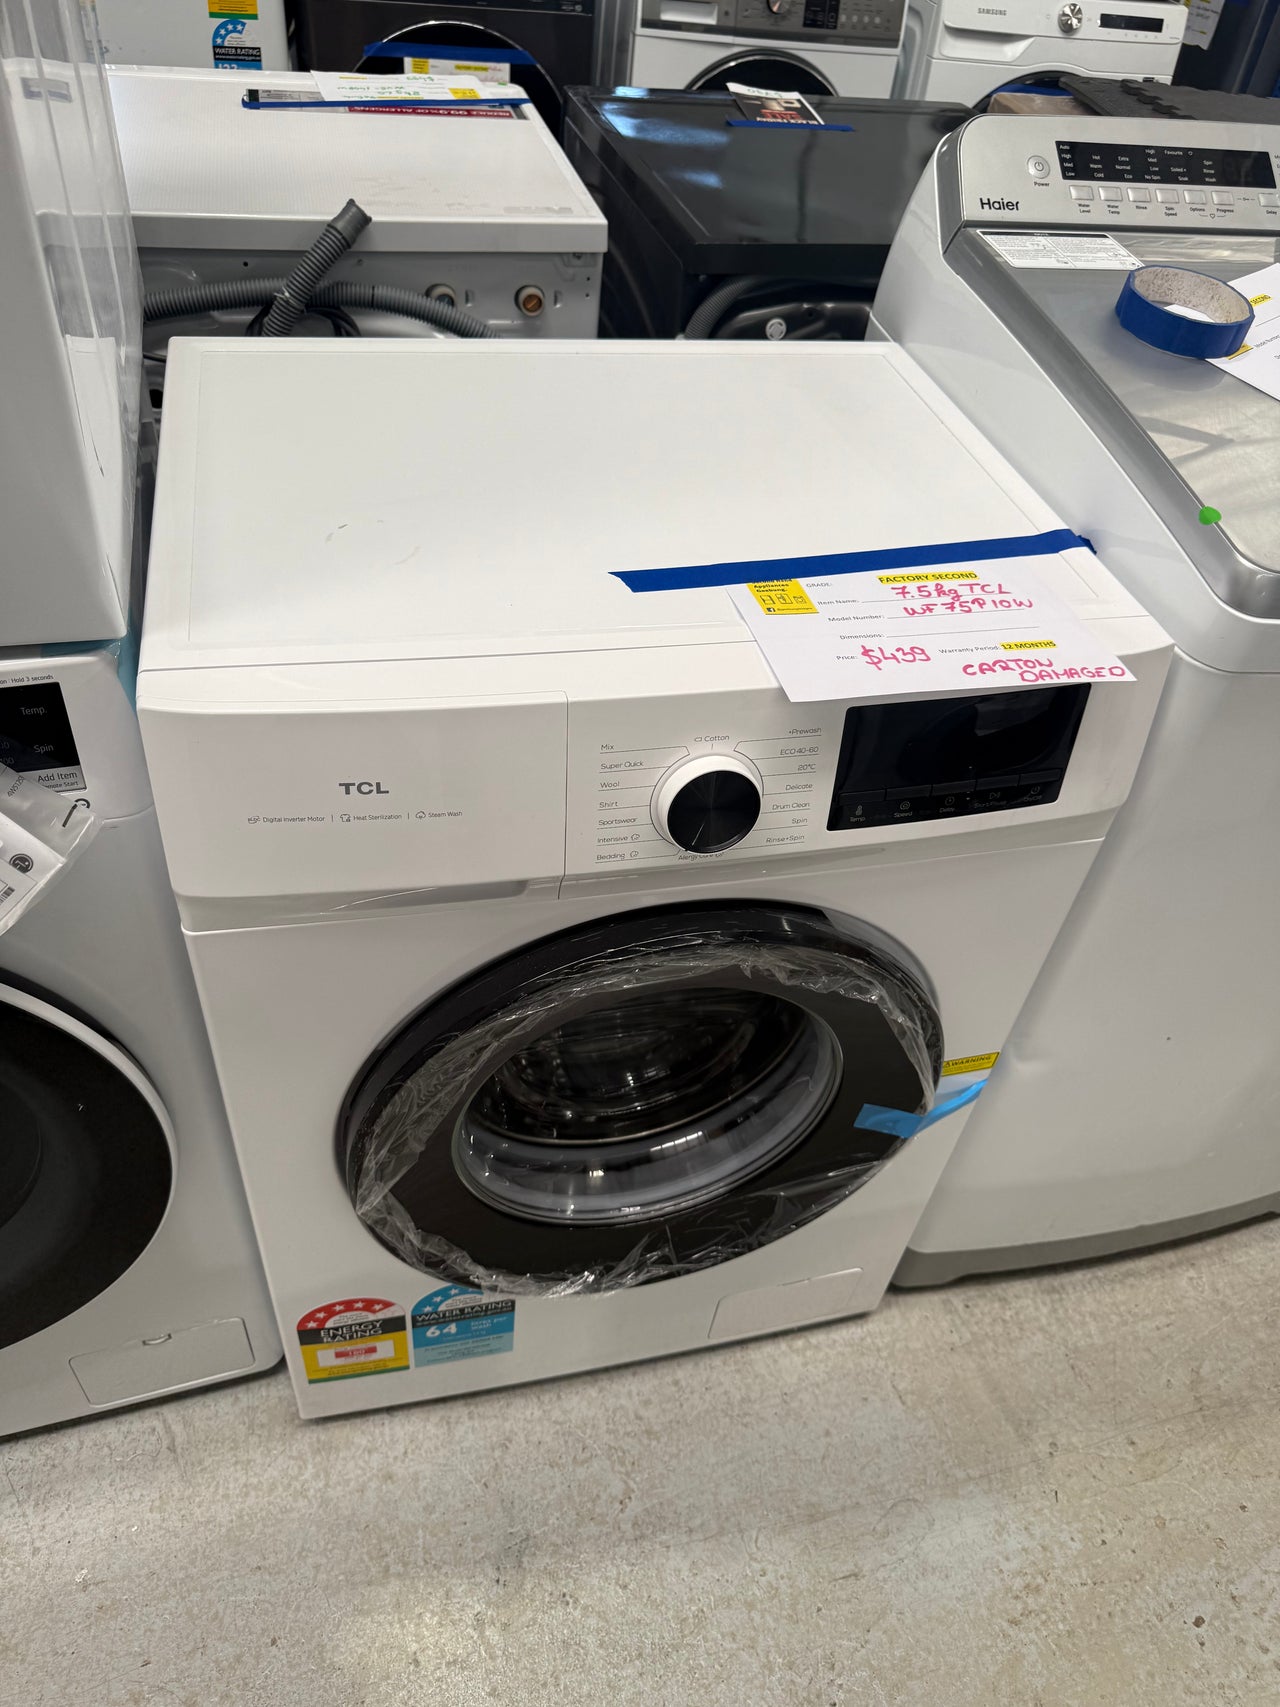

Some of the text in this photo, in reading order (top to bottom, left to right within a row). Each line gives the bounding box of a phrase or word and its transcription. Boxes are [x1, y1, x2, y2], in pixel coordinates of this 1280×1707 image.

[977, 8, 1007, 16] SAMSUNG
[979, 197, 1019, 211] Haier
[878, 572, 978, 584] FACTORY SECOND
[958, 583, 1012, 595] TCL
[939, 647, 974, 655] Warranty
[1001, 642, 1014, 650] 12
[1014, 640, 1057, 649] MONTHS
[861, 644, 932, 671] $439
[31, 674, 54, 682] seconds
[1018, 666, 1126, 683] DAMAGED
[20, 706, 47, 716] Temp.
[704, 734, 730, 743] Cotton
[33, 744, 55, 754] Spin
[600, 743, 615, 751] Mix
[796, 746, 819, 754] 40-60
[600, 763, 622, 772] Super
[38, 771, 78, 783] Add Item
[338, 781, 390, 796] TCL
[600, 781, 620, 789] Wool
[785, 783, 813, 791] Delicate
[599, 801, 619, 809] Shirt
[772, 801, 810, 811] Drum Clean
[368, 813, 402, 821] Sterilization
[791, 817, 808, 826] Spin
[598, 818, 638, 827] Sportswear
[597, 836, 629, 844] Intensive
[765, 834, 805, 844] Rinse+Spin
[596, 852, 626, 861] Bedding
[951, 1056, 991, 1066] WARNING
[416, 1309, 461, 1320] WATER
[463, 1301, 512, 1313] RATING
[320, 1321, 383, 1338] ENERGY
[425, 1322, 457, 1338] 64
[323, 1328, 382, 1343] RATING
